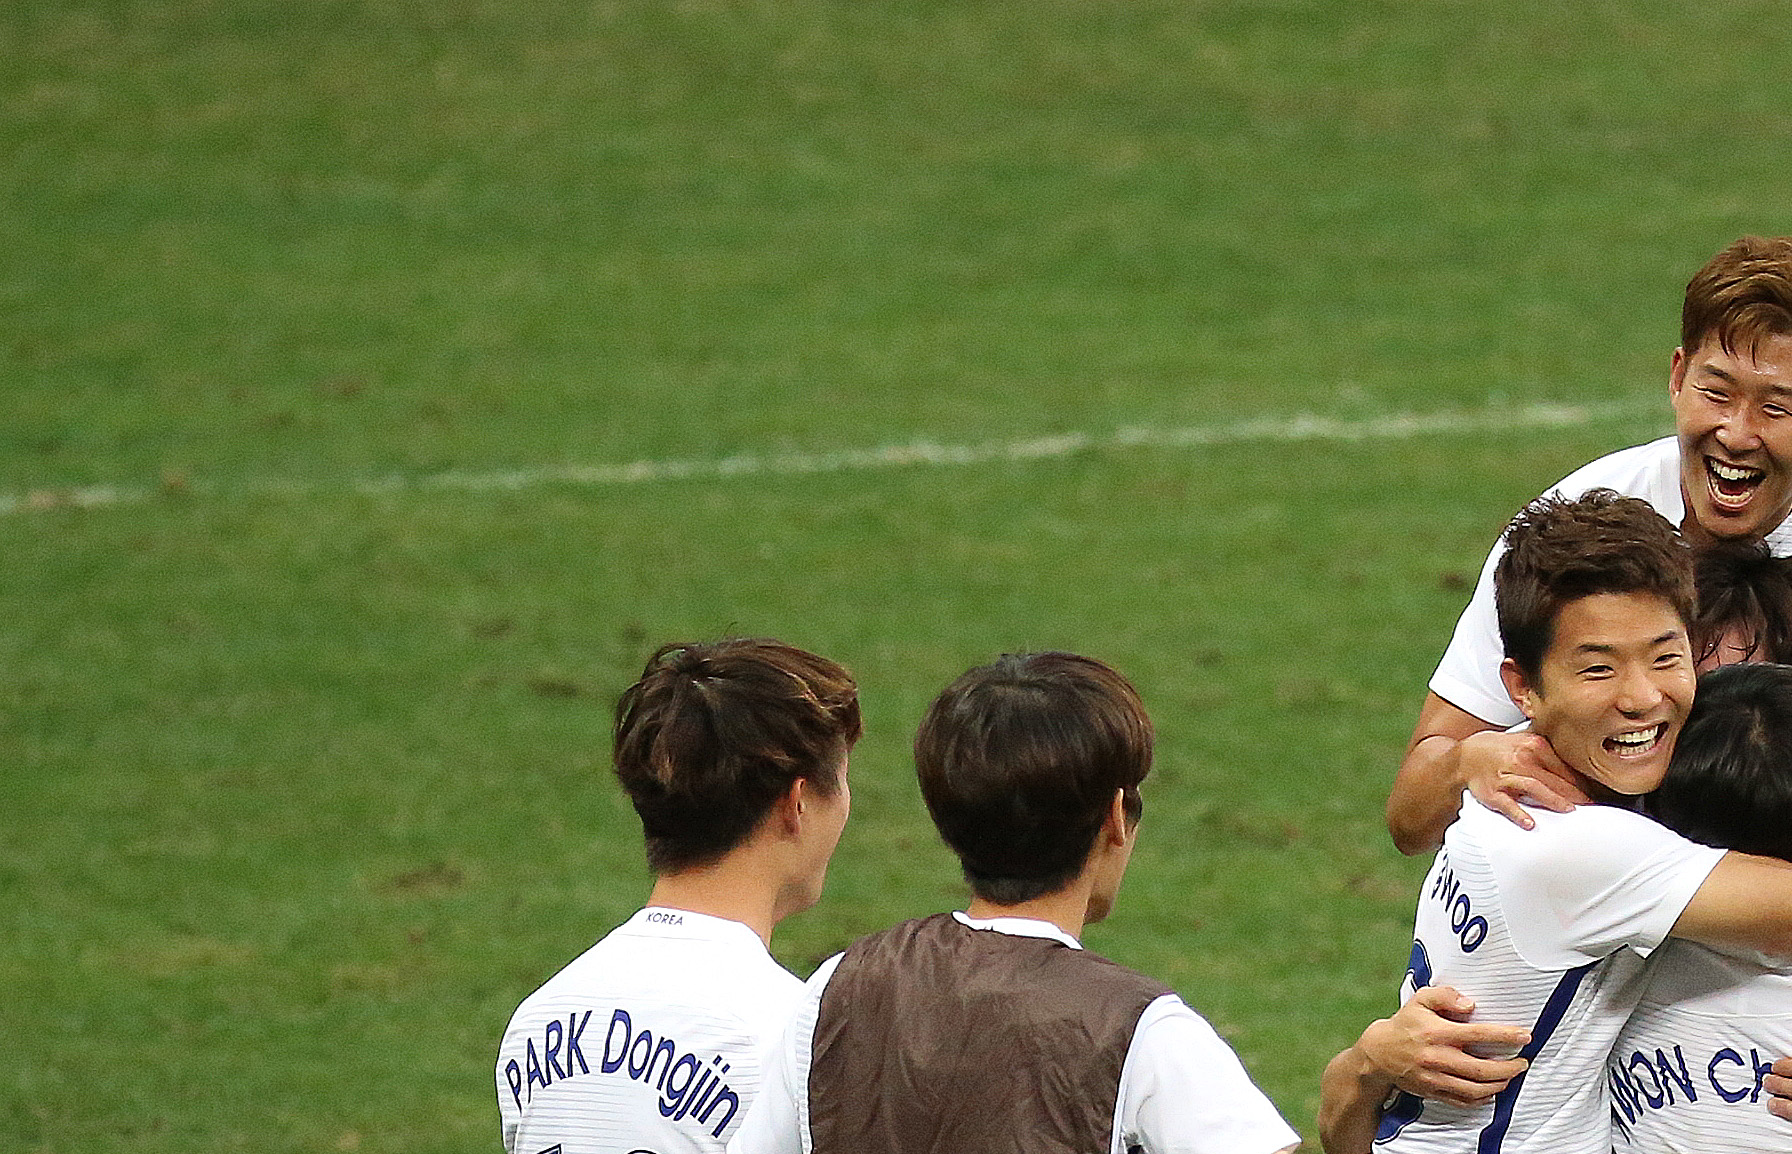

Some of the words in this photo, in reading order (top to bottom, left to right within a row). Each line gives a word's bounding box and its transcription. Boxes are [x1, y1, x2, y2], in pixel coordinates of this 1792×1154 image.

[646, 912, 683, 926] KOREA
[505, 1010, 593, 1116] PARK
[601, 1009, 739, 1139] Dongjin
